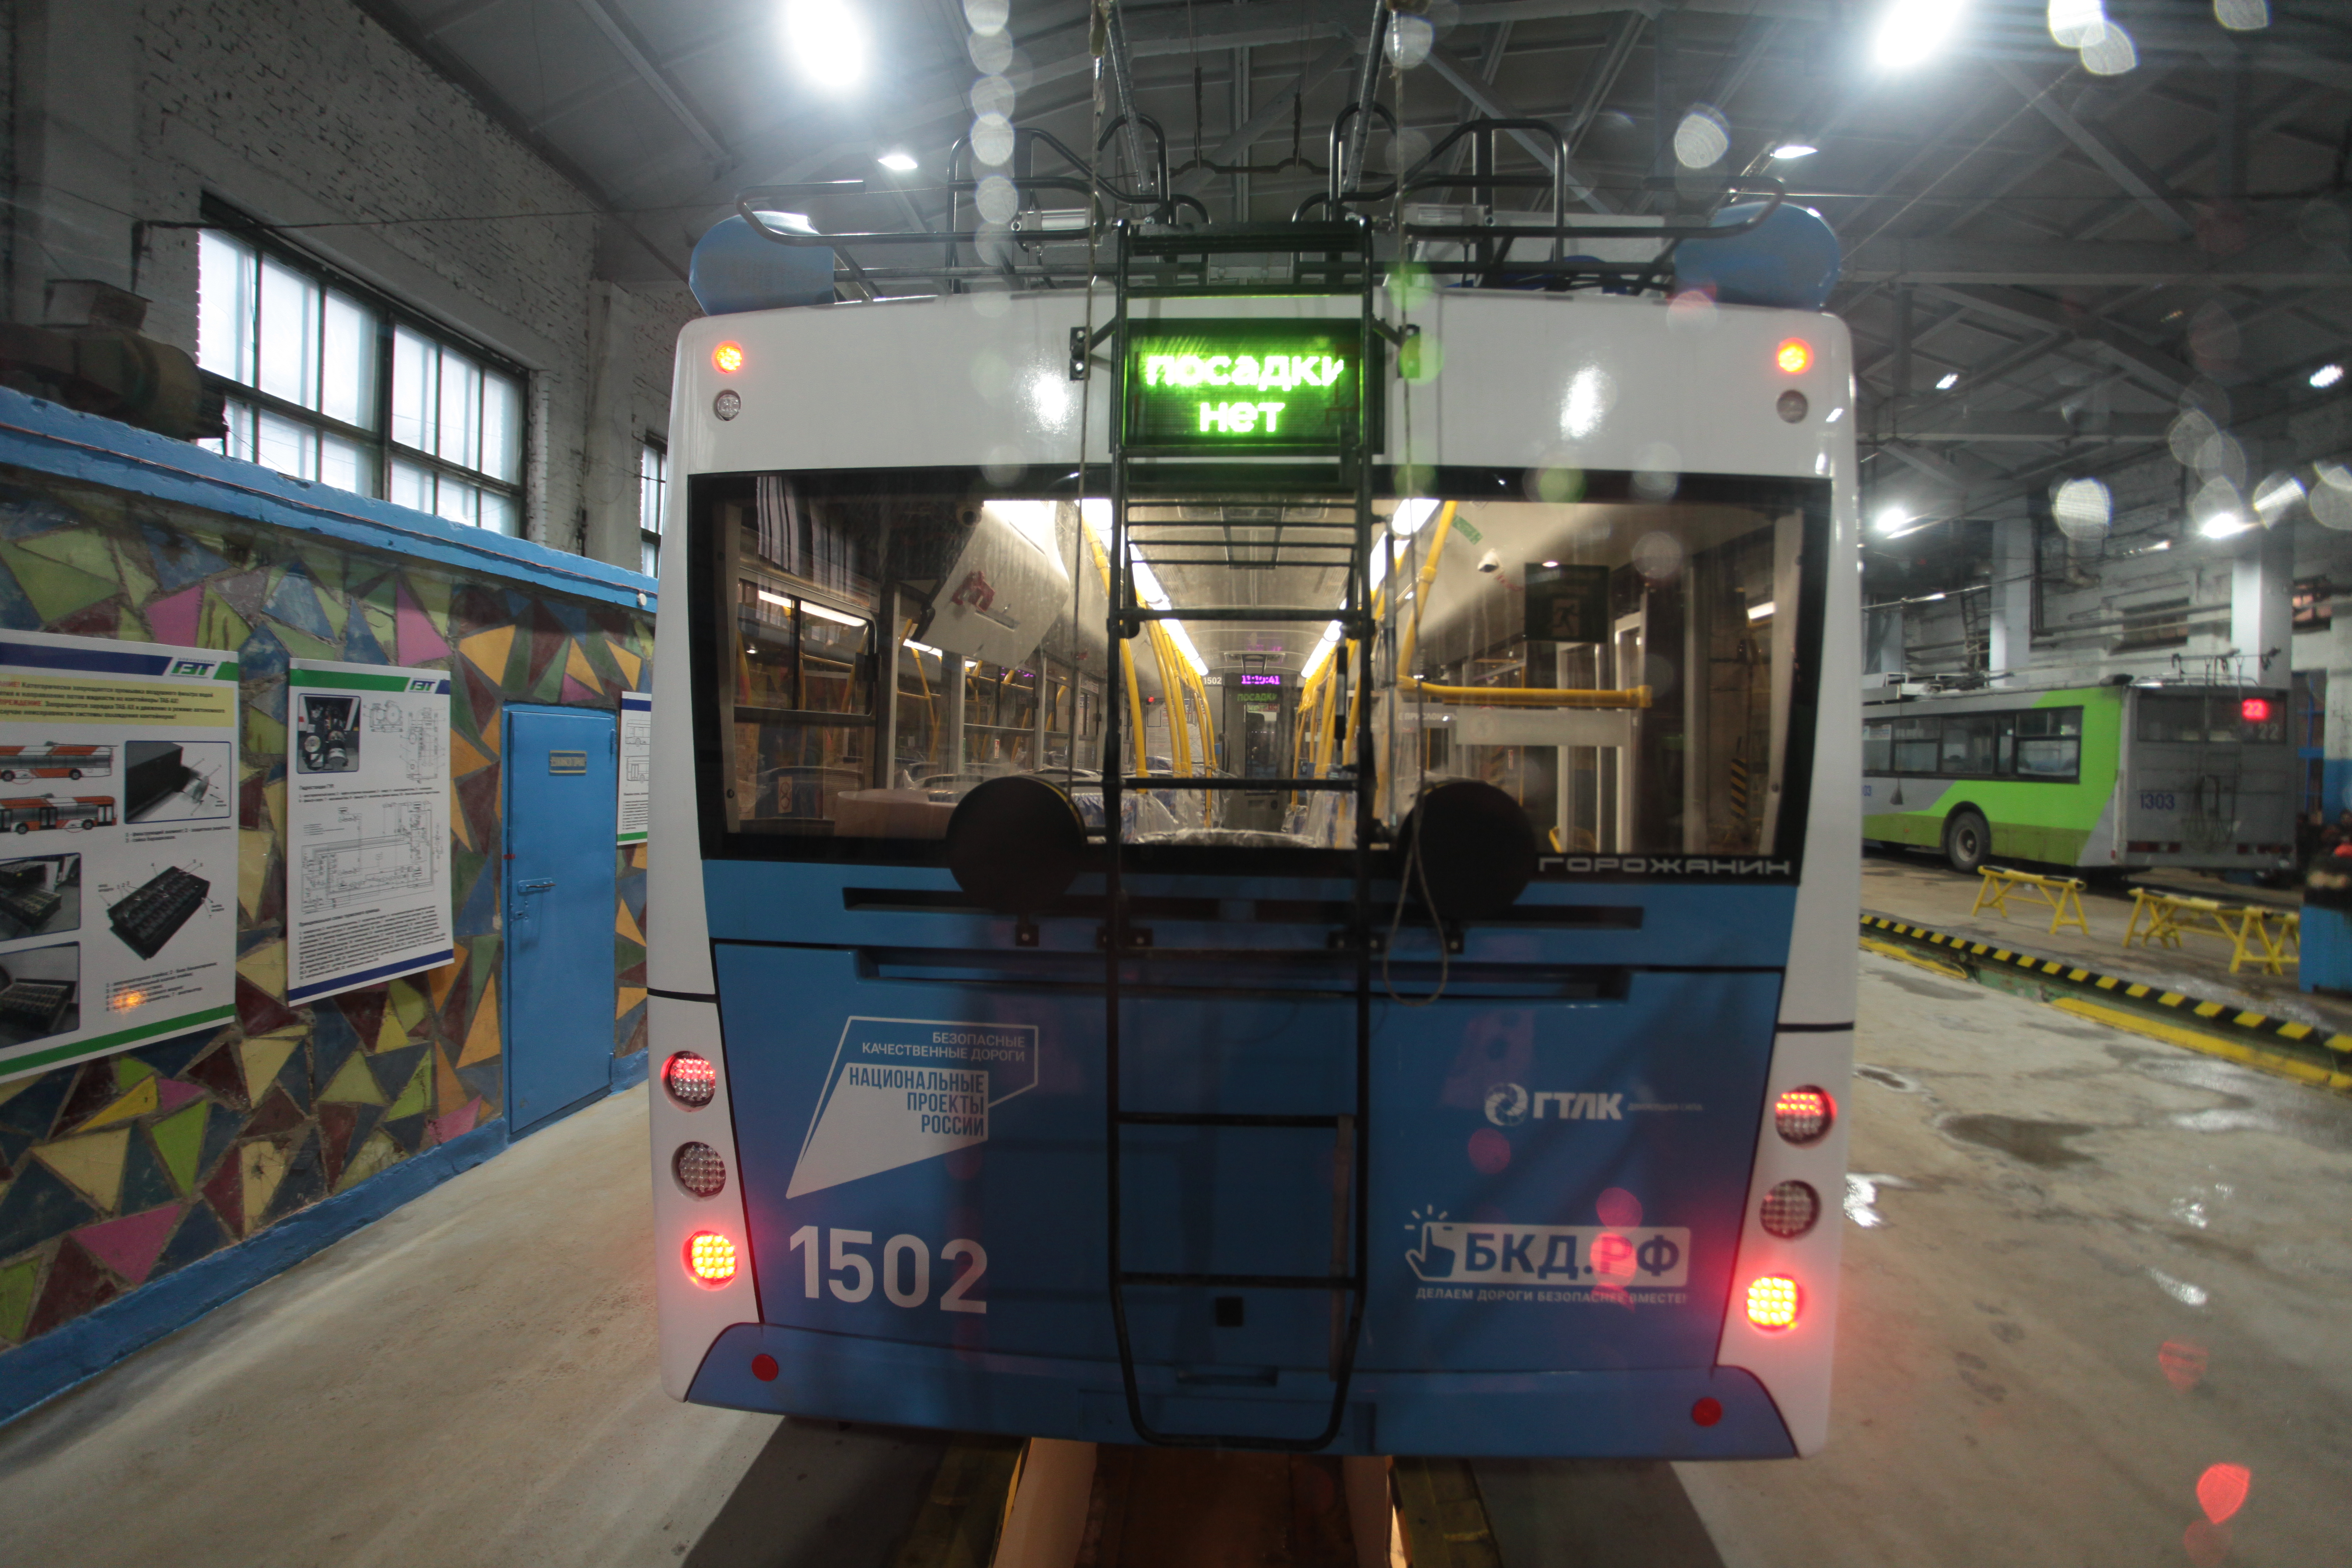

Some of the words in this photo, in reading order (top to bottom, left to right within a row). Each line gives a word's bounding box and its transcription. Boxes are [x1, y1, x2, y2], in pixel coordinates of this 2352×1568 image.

[1199, 402, 1285, 432] нет
[2141, 794, 2175, 810] 1303
[1538, 856, 1791, 876] ГОРОЖАНИН
[932, 1032, 1026, 1048] БЕЗОПАСНЫЕ
[862, 1042, 968, 1059] КАЧЕСТВЕННЫЕ
[971, 1048, 1026, 1063] ДОРОГИ
[849, 1067, 984, 1093] НАЦИОНАЛЬНЫЕ
[907, 1092, 984, 1115] ПРОЕКТЫ
[1533, 1091, 1624, 1120] ГТЛК
[922, 1114, 984, 1137] РОССИИ
[1465, 1232, 1680, 1280] БКД.РФ
[789, 1225, 988, 1314] 1502
[1416, 1287, 1474, 1300] ДЕЛАЕМ
[1476, 1289, 1533, 1303] ДОРОГИ
